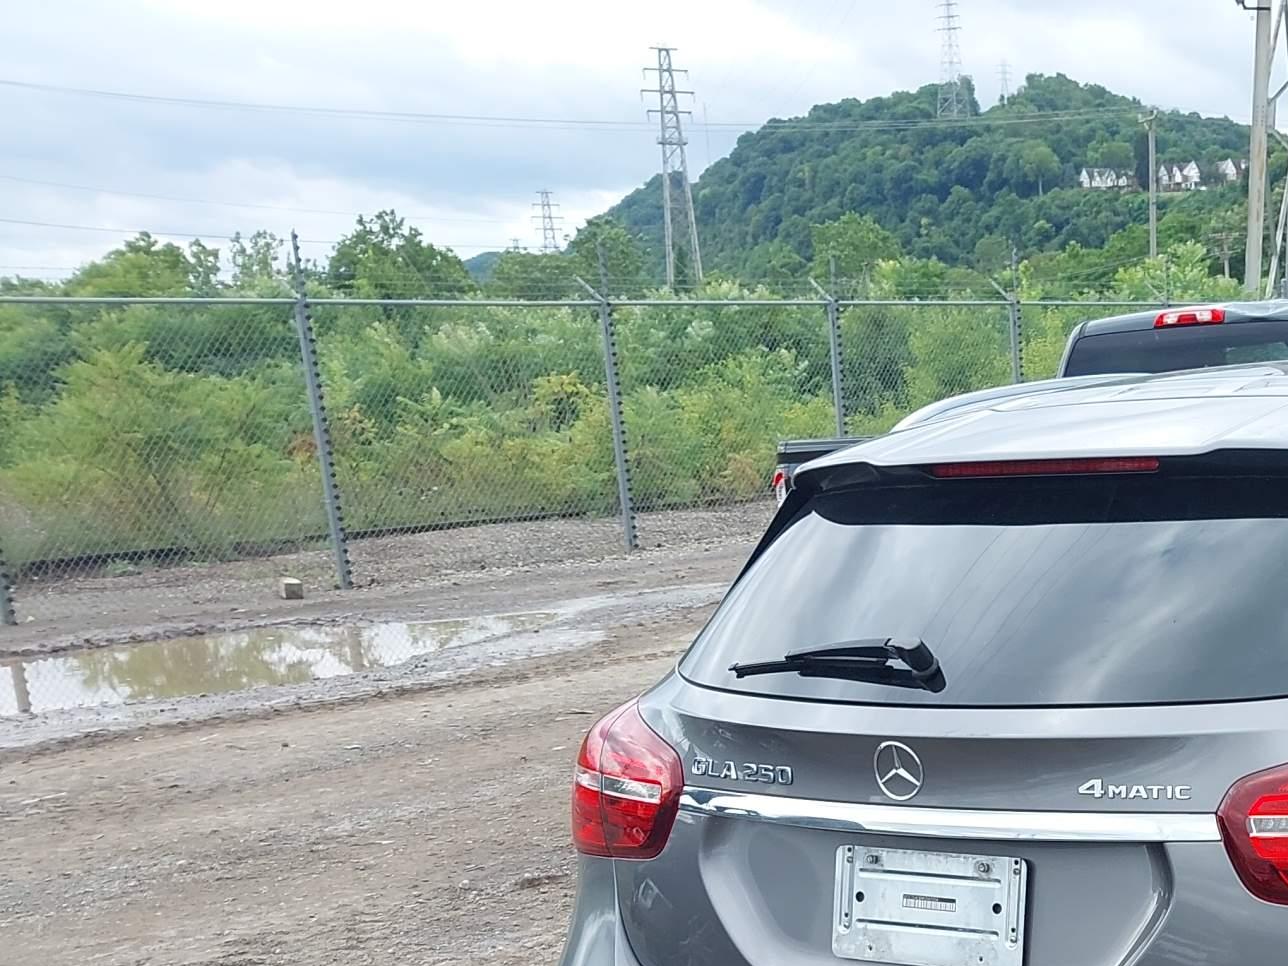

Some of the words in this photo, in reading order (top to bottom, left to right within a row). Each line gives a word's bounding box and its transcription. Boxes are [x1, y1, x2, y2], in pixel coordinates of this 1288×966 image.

[691, 757, 738, 780] GLA
[743, 763, 793, 785] 250
[1078, 778, 1192, 800] 4MATIC
